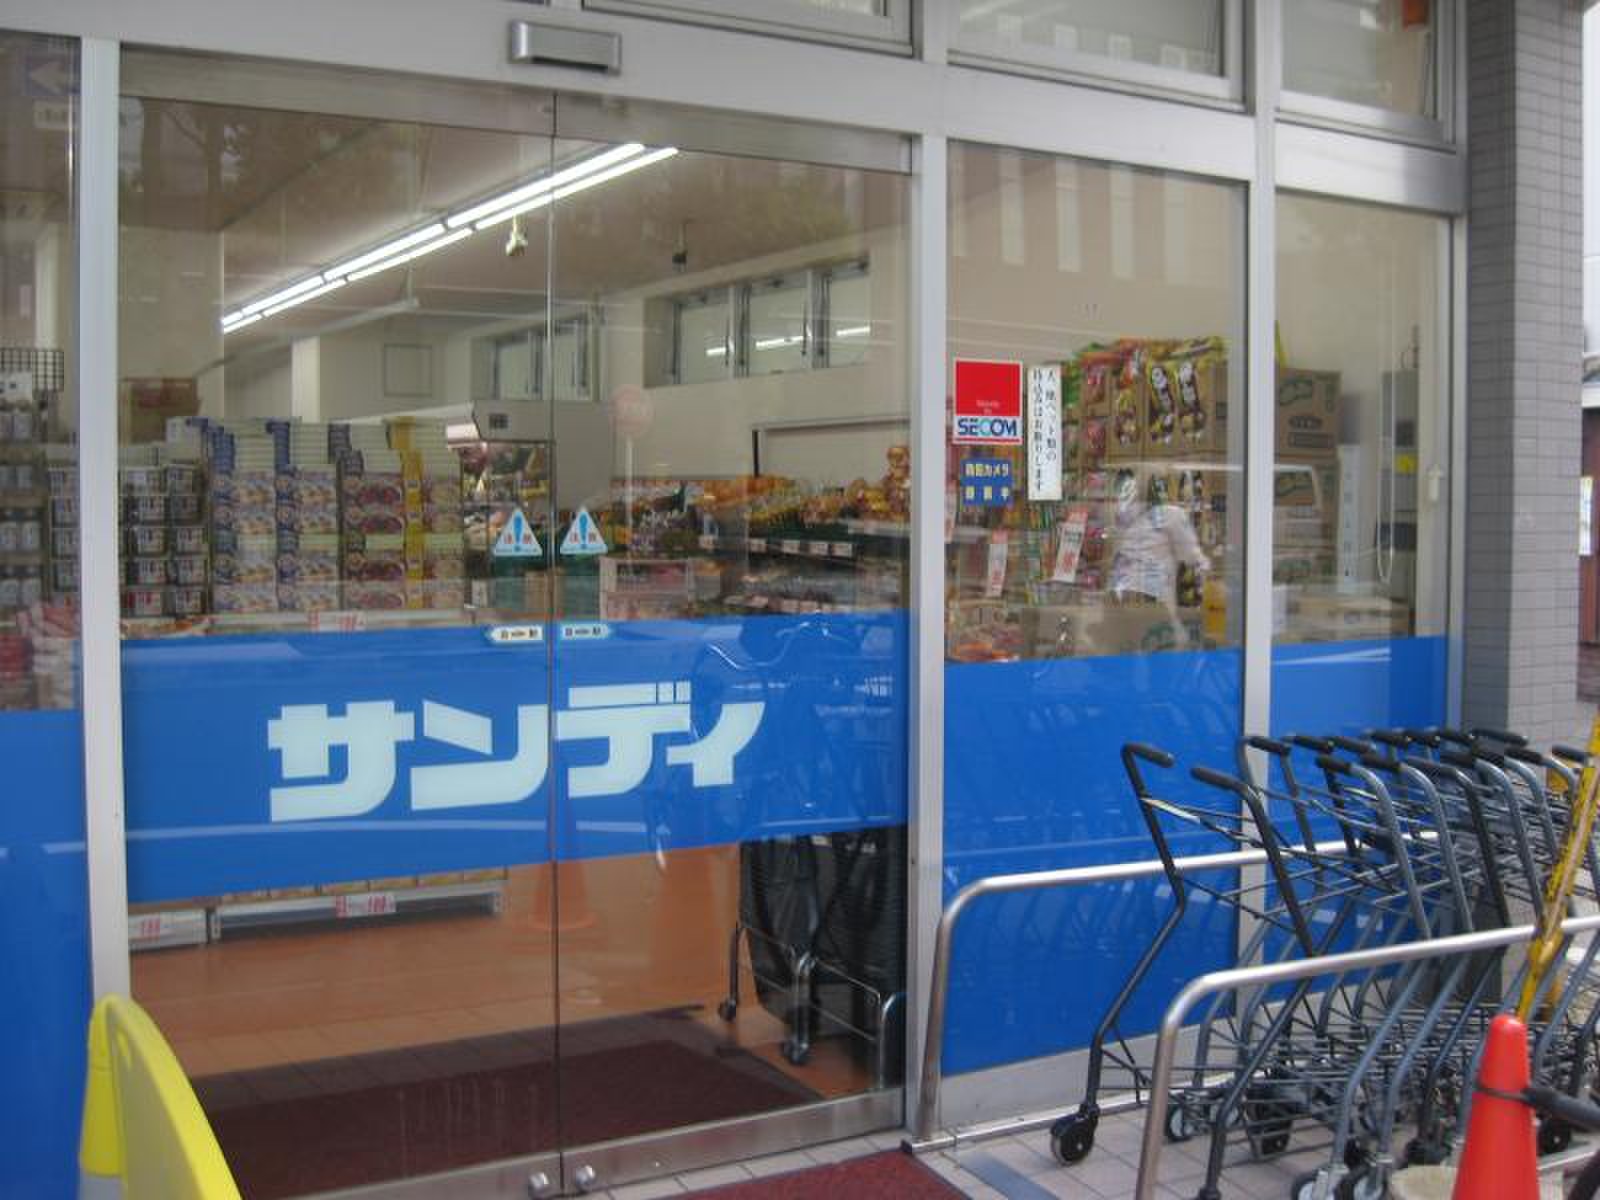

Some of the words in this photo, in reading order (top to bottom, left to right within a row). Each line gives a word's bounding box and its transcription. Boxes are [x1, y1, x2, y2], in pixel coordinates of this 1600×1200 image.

[957, 416, 1018, 437] SECOM
[267, 681, 766, 823] サンディ
